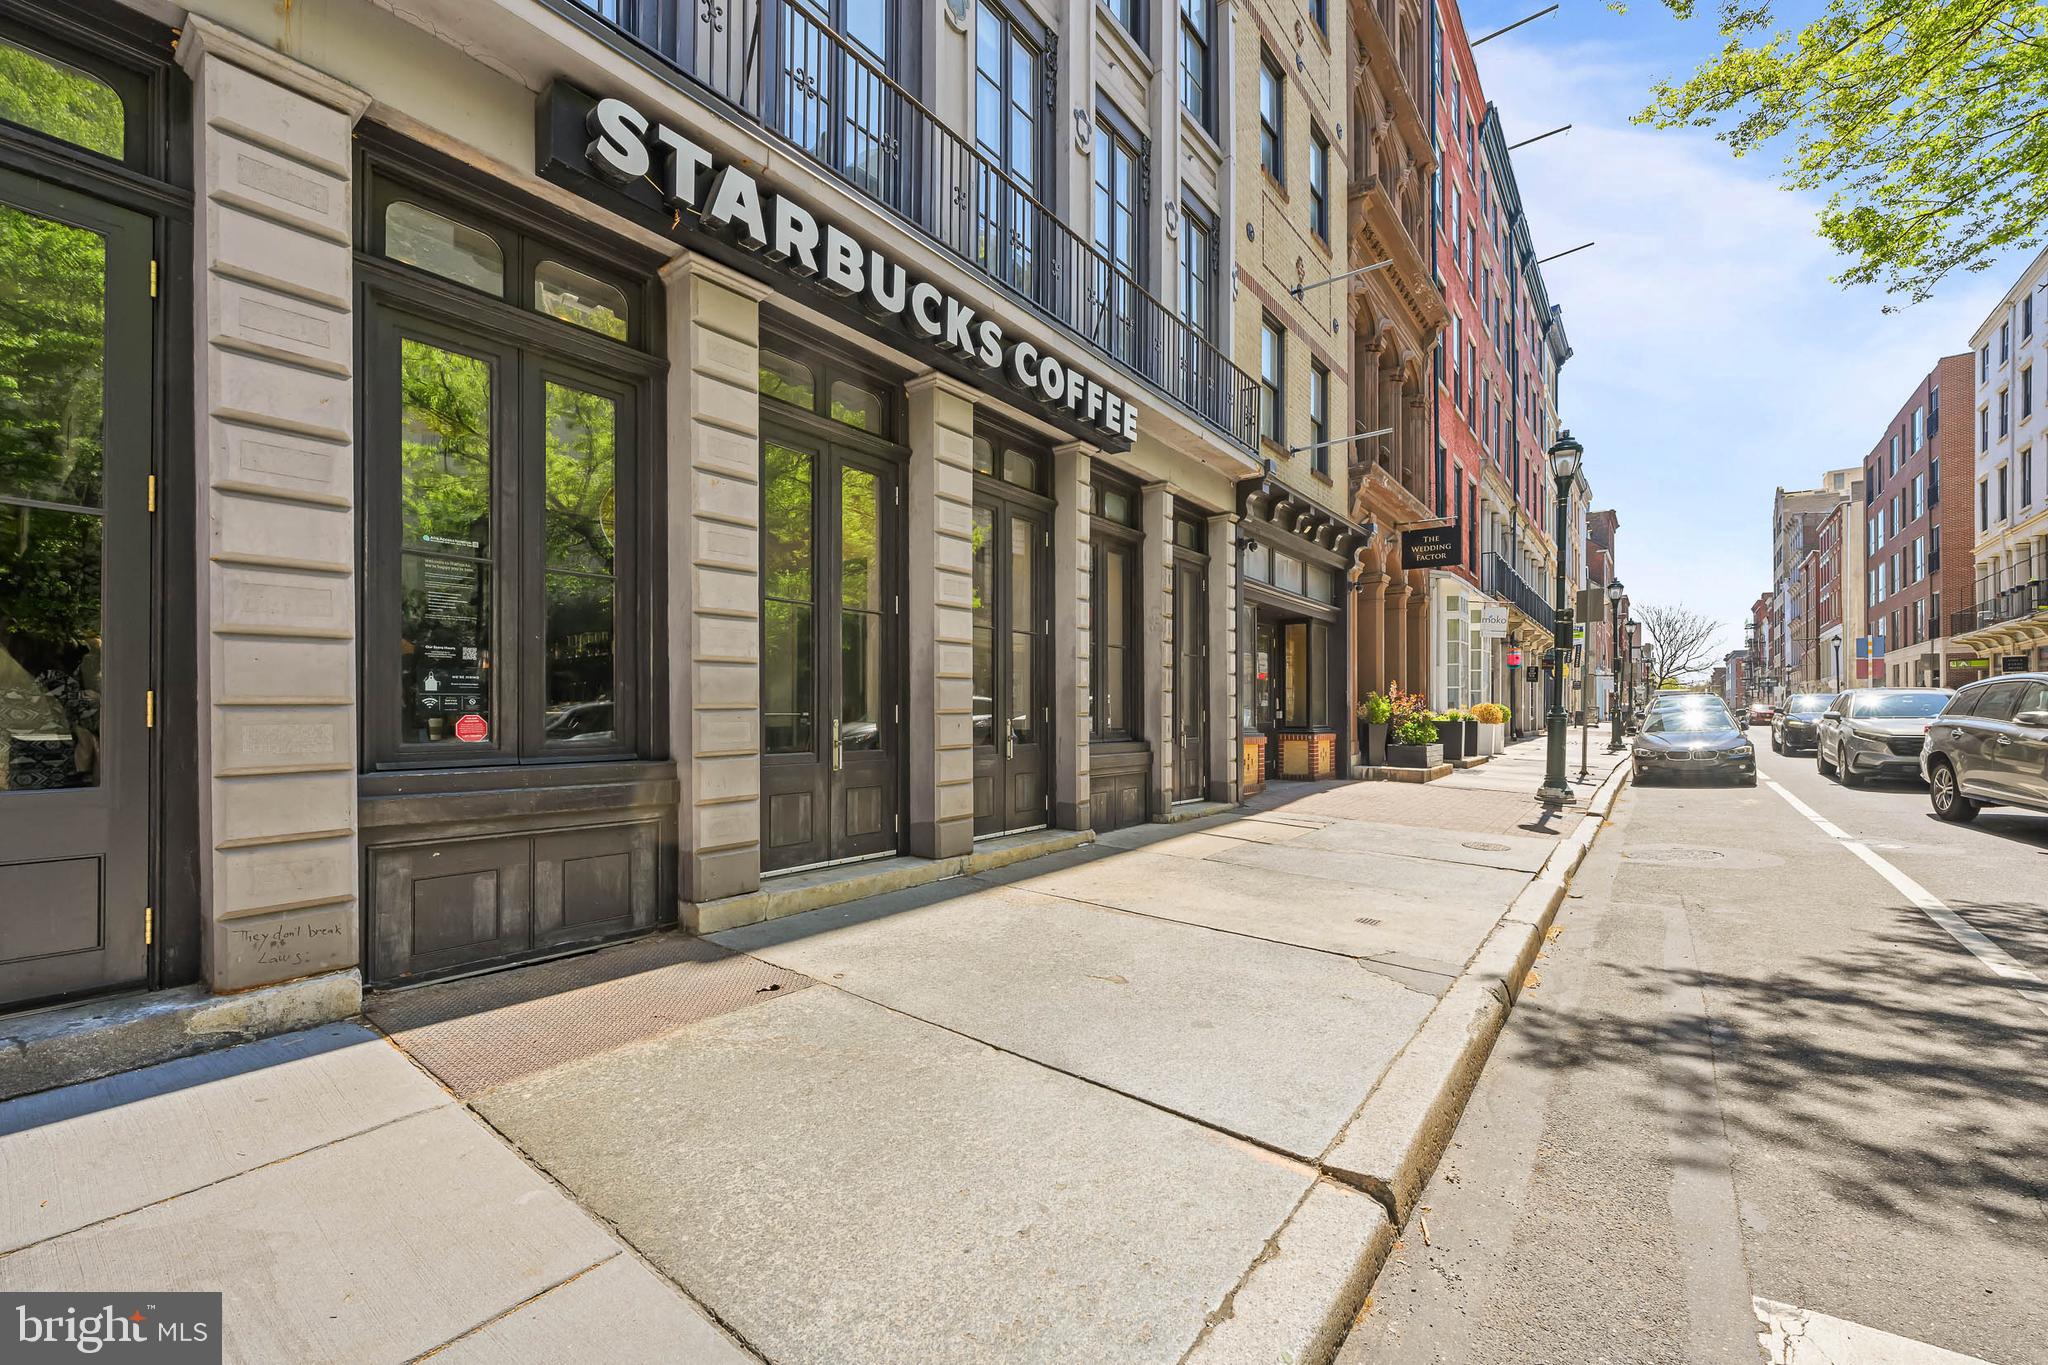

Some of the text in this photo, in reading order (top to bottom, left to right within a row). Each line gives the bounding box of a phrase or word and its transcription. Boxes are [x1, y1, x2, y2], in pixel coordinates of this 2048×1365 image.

[596, 98, 1139, 443] STARBUCKS COFFEE
[1423, 535, 1440, 543] THE
[1411, 542, 1452, 553] WEDDING
[1416, 552, 1447, 561] FACTOR
[1482, 615, 1507, 624] moko
[232, 930, 268, 952] They
[308, 924, 342, 938] break
